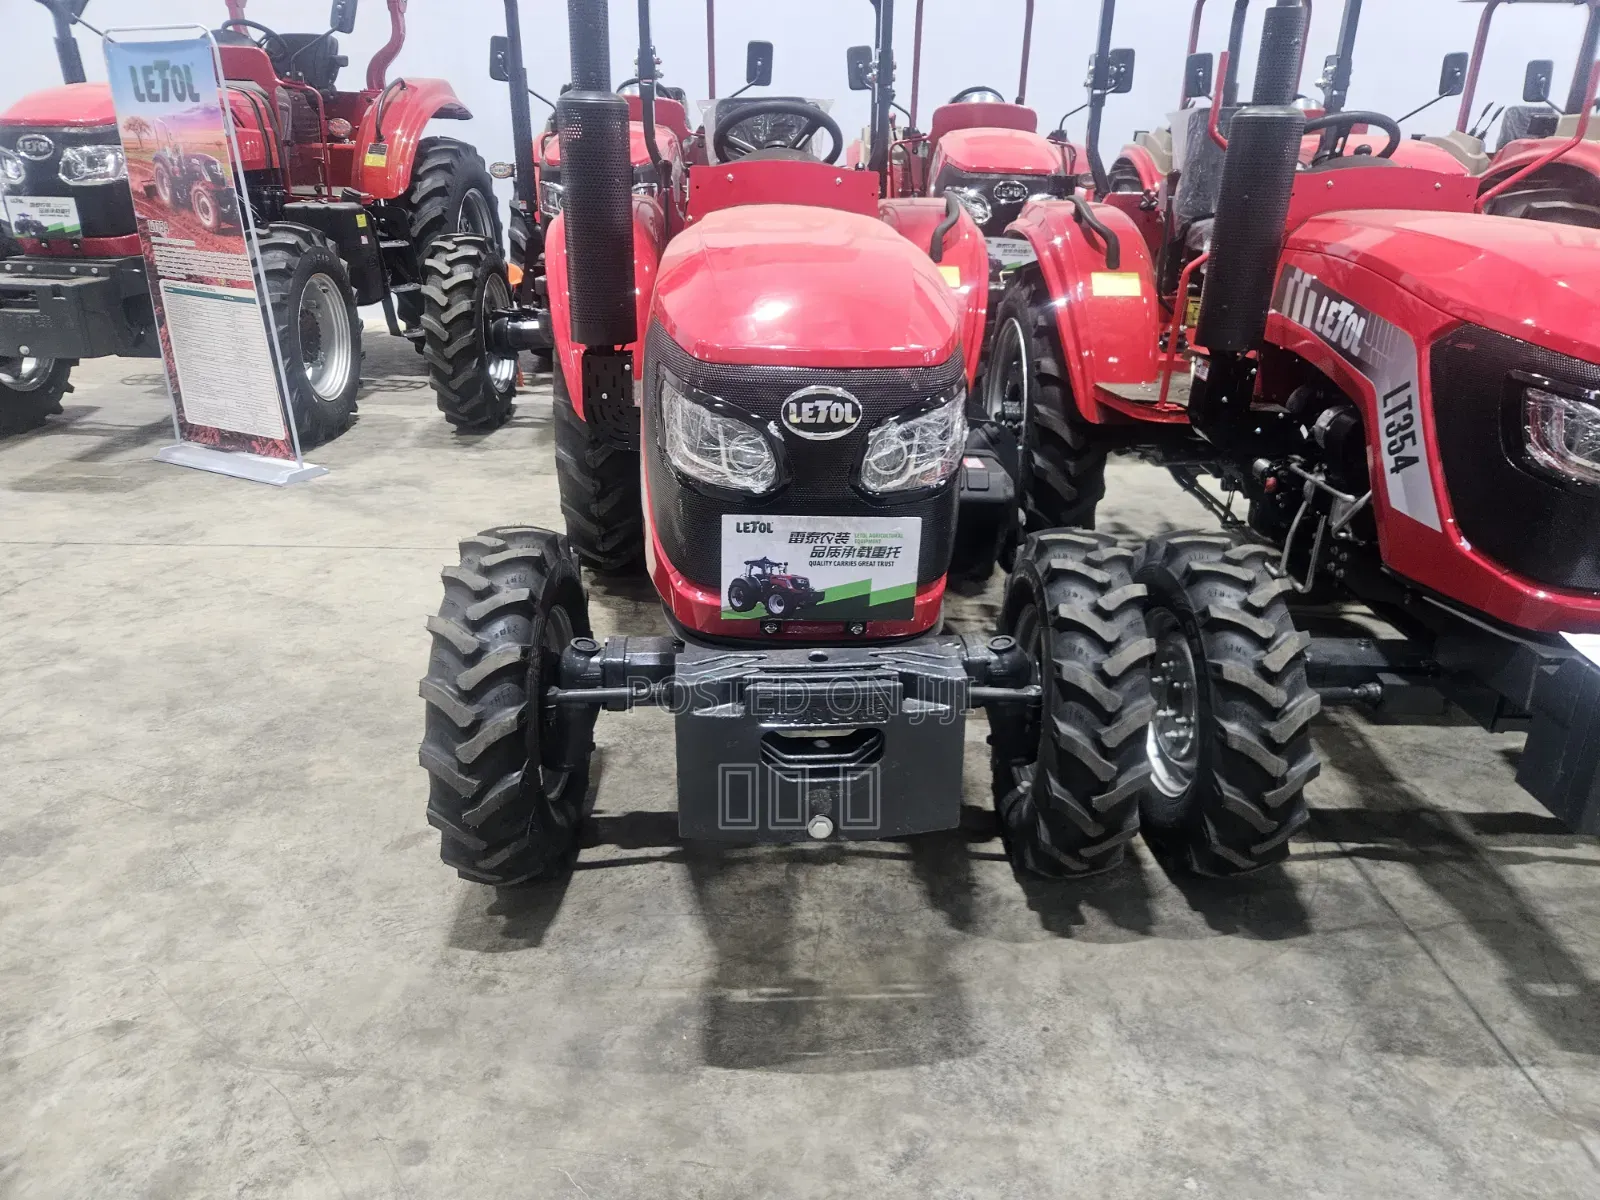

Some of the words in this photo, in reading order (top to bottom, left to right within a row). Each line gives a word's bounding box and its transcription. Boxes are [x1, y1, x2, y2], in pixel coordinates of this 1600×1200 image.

[128, 60, 200, 103] LETOL
[1315, 295, 1366, 357] LETOL
[788, 400, 857, 423] LETOL
[1382, 380, 1420, 475] LT354
[736, 521, 773, 534] LETOL
[788, 531, 851, 545] 雷泰农装
[809, 545, 902, 559] 品质承载重托
